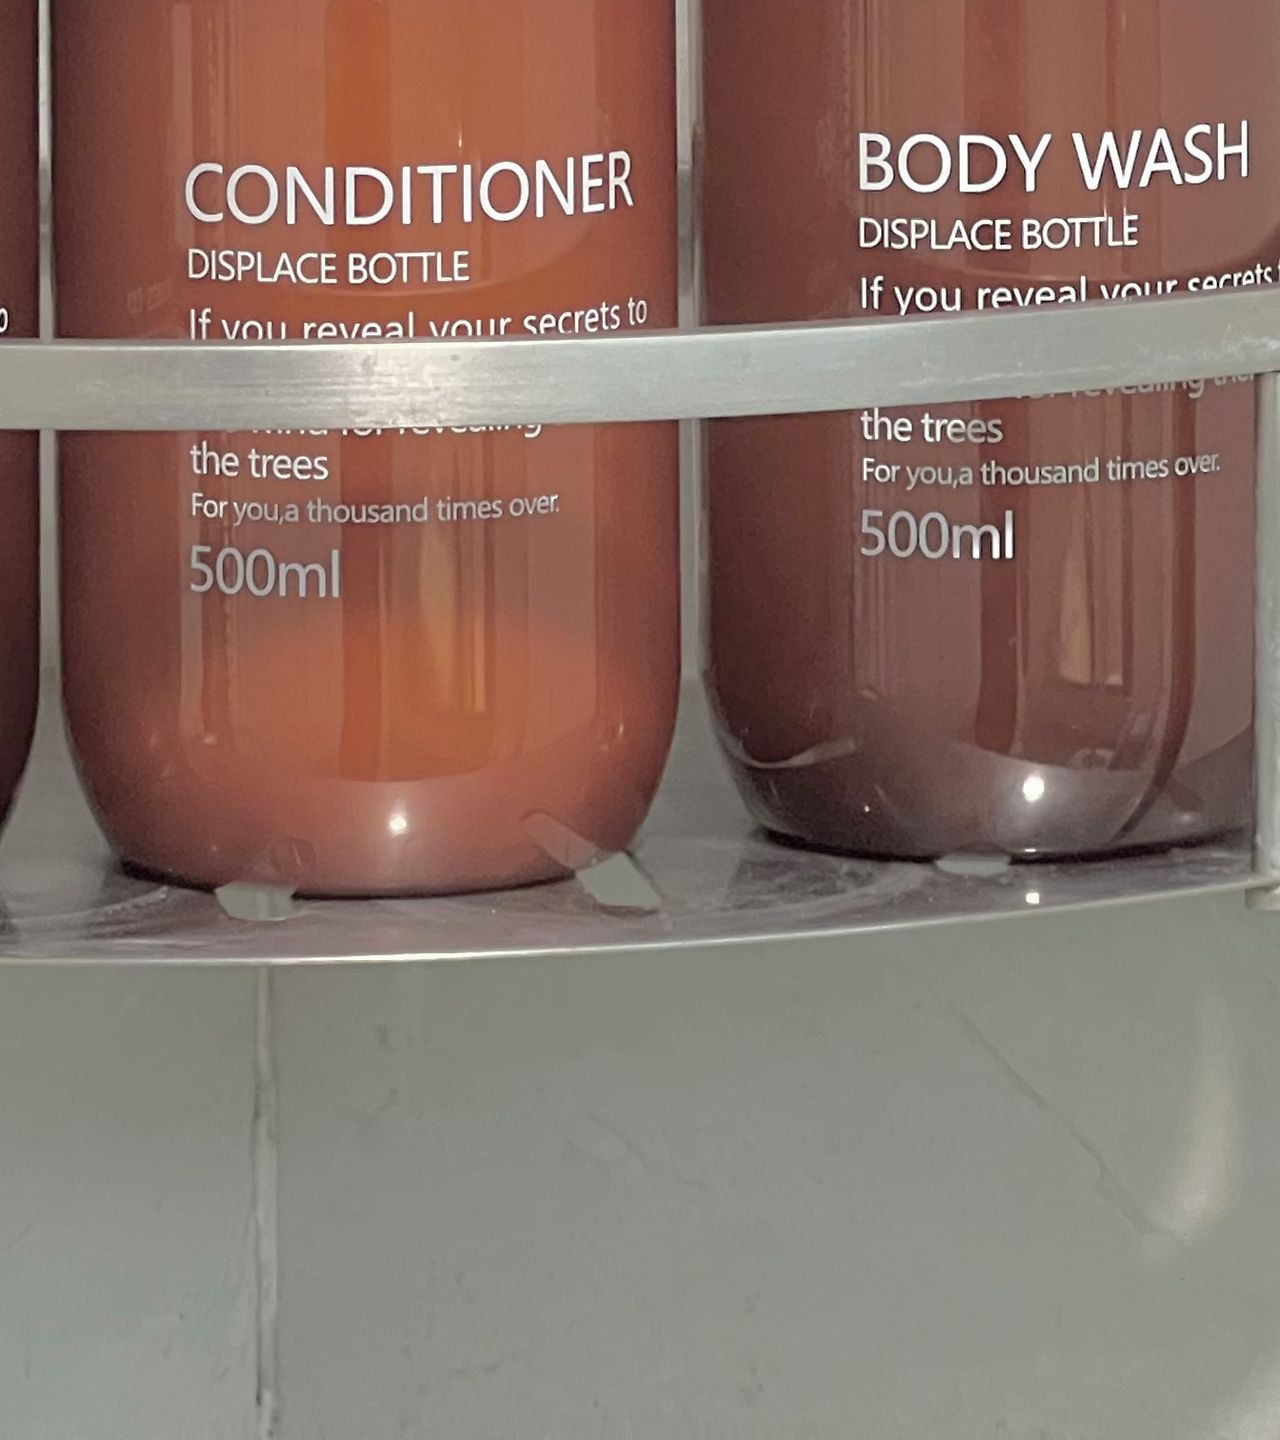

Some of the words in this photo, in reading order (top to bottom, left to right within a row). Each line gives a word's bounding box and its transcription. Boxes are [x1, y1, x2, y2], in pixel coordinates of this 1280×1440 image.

[857, 132, 1051, 194] BODY
[1072, 119, 1250, 192] WASH
[184, 149, 634, 226] CONDITIONER
[858, 216, 1012, 251] DISPLACE
[1022, 213, 1139, 250] BOTTLE
[187, 248, 337, 285] DISPLACE
[347, 249, 470, 285] BOTTLE
[861, 276, 884, 310] If
[894, 286, 962, 316] you
[978, 275, 1087, 310] reveal
[190, 308, 212, 340] If
[523, 301, 621, 335] secrets
[628, 296, 649, 326] to
[860, 409, 913, 442] the
[921, 411, 1004, 443] trees
[190, 441, 240, 478] the
[248, 447, 329, 481] trees
[861, 458, 900, 483] For
[980, 456, 1100, 486] thousand
[1106, 456, 1169, 480] times
[1174, 452, 1221, 477] over.
[192, 493, 228, 519] For
[307, 496, 428, 523] thousand
[437, 496, 503, 520] times
[509, 492, 560, 516] over.
[859, 510, 1014, 560] 500ml
[190, 545, 341, 598] 500ml
